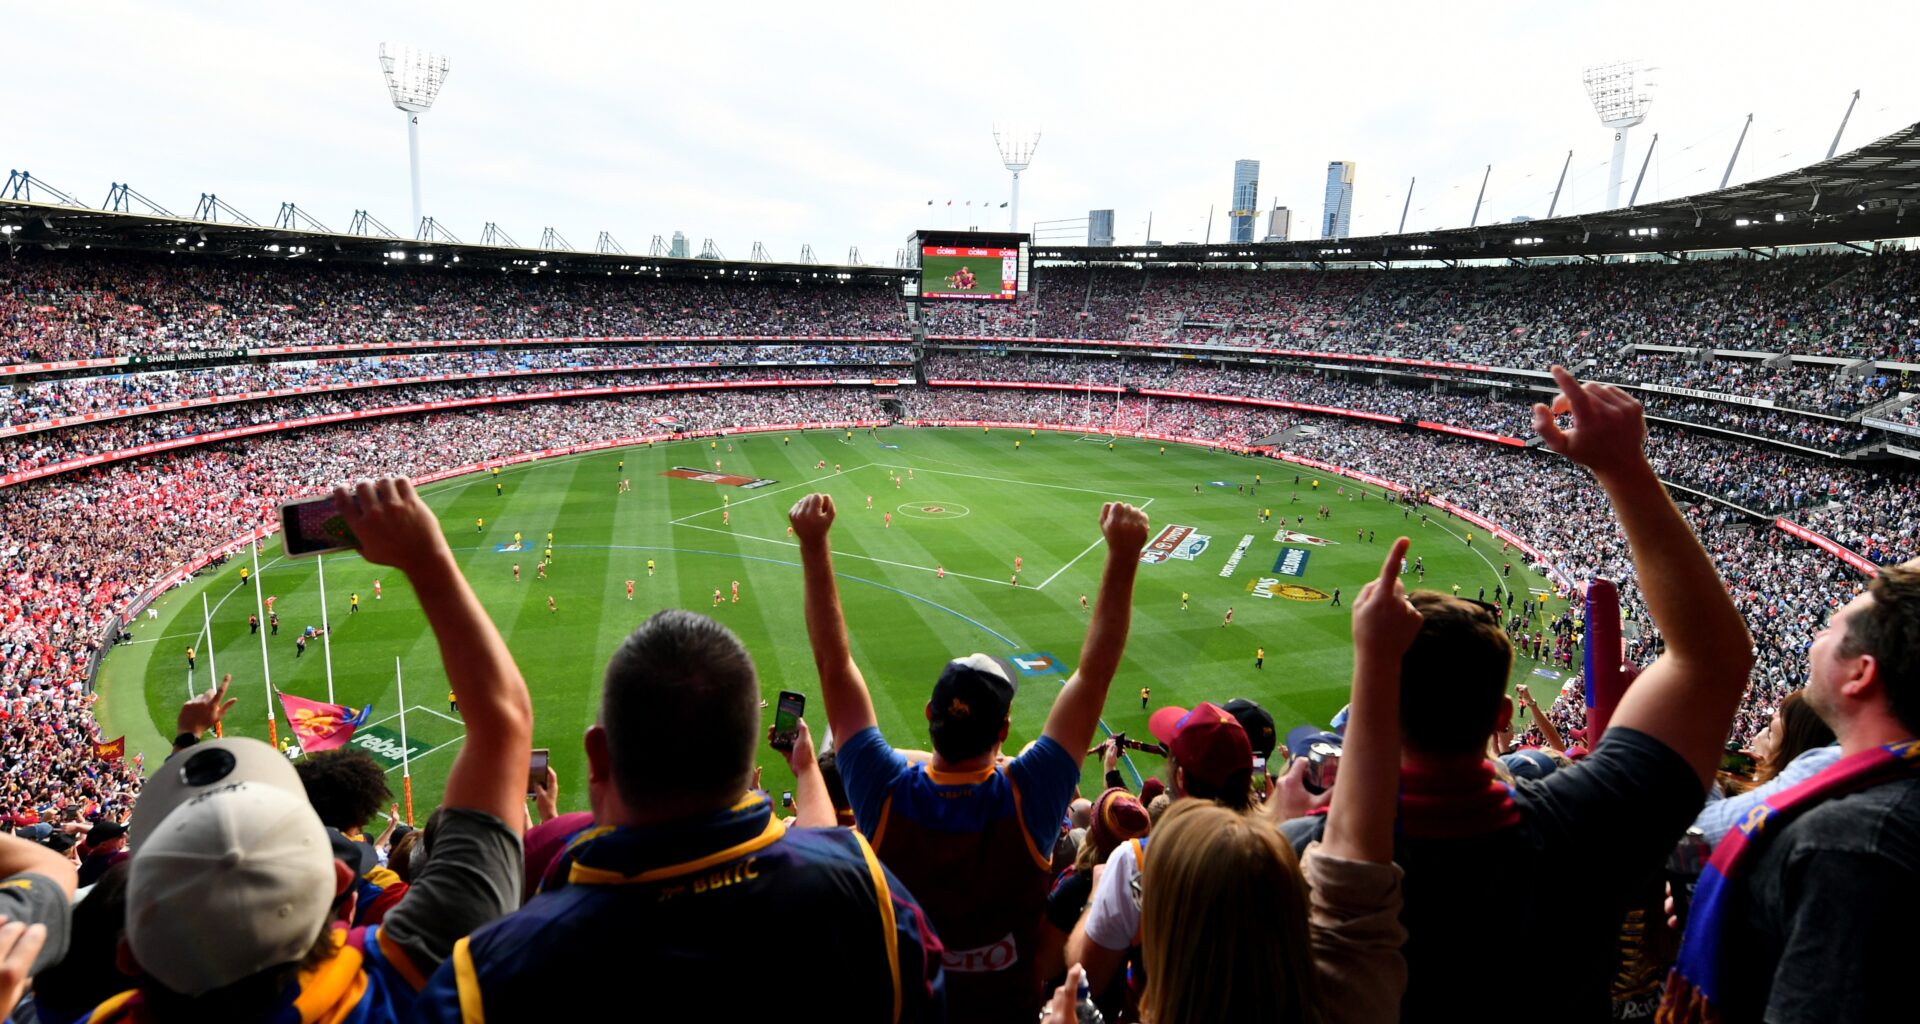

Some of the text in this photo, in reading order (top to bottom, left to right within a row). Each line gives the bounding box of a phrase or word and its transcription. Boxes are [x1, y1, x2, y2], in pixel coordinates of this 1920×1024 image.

[412, 116, 418, 125] 4
[1615, 132, 1621, 141] 6
[146, 350, 234, 363] SHANE WARNE STAND
[1657, 386, 1753, 405] MELBOURNE CRICKET CLUB
[22, 469, 42, 479] TOYOTA
[1251, 577, 1279, 599] LIONS
[350, 733, 418, 760] rebel
